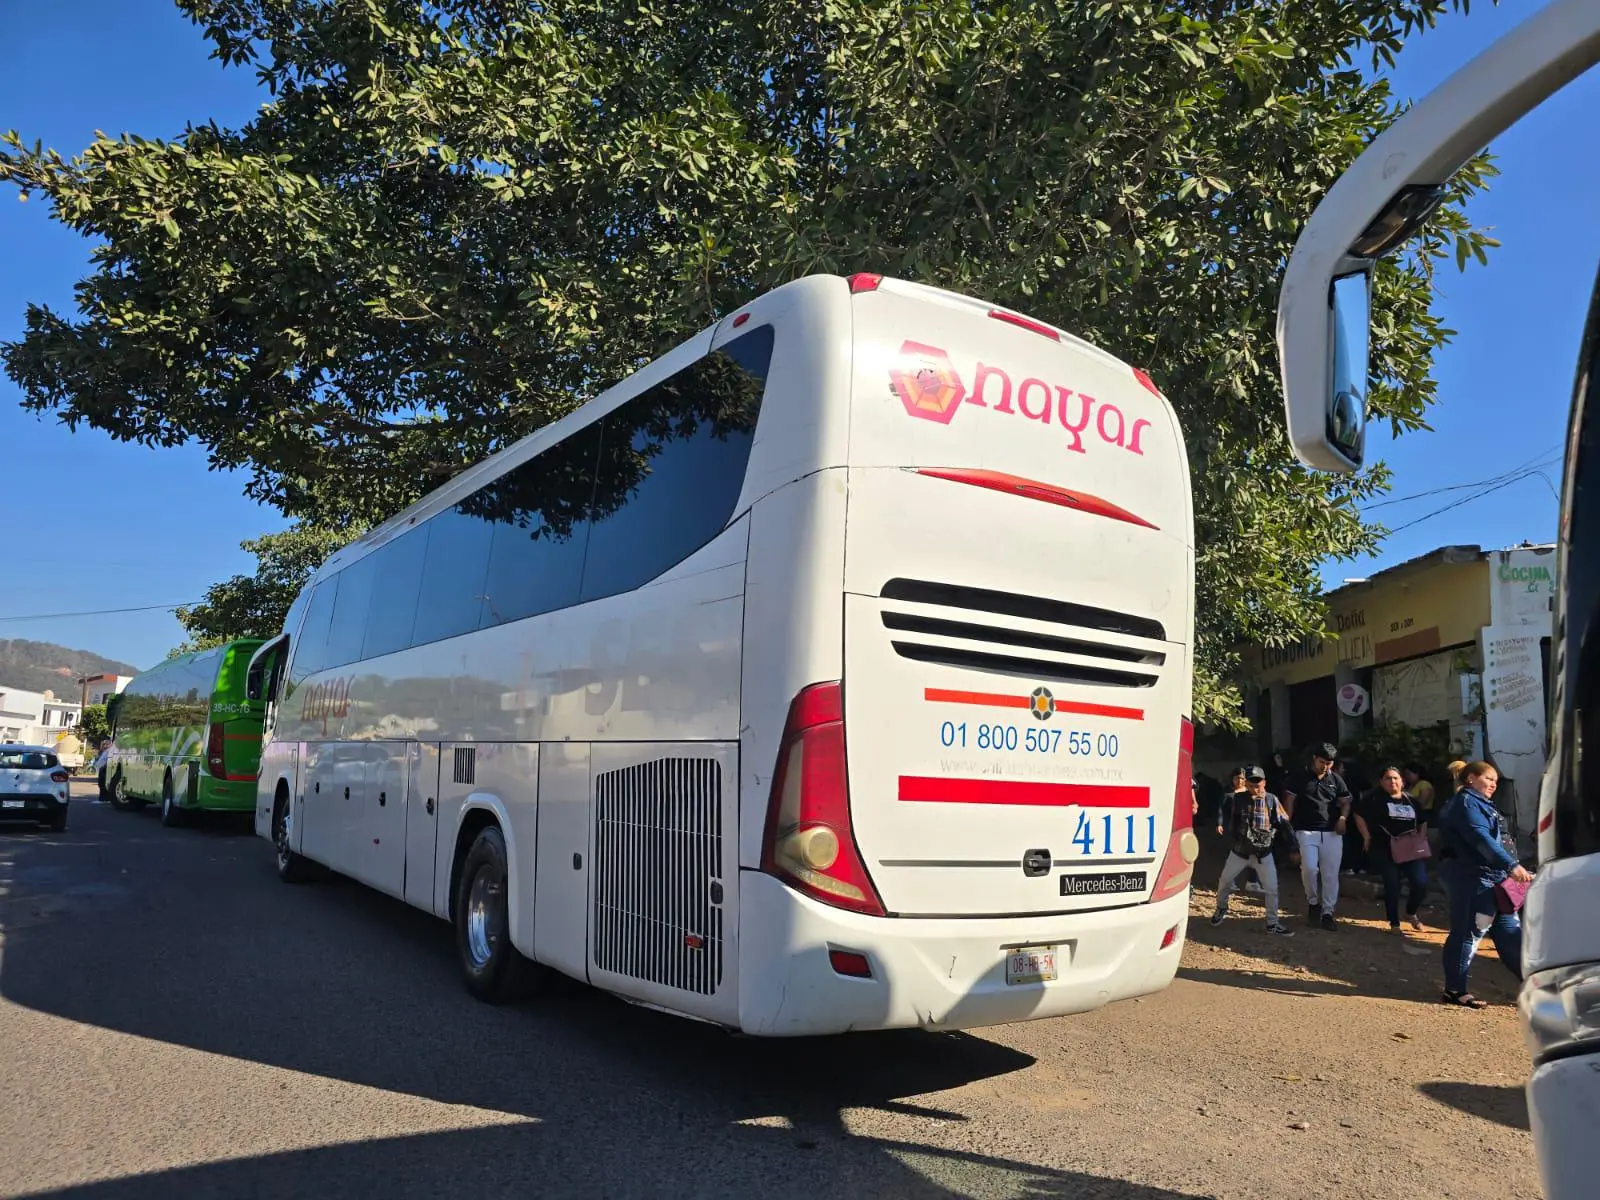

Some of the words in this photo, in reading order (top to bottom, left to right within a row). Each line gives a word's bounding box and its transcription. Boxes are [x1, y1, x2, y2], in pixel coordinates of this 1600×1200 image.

[940, 721, 968, 747] 01
[977, 724, 1018, 751] 800
[1025, 728, 1062, 753] 507
[1069, 731, 1092, 756] 55
[1097, 734, 1119, 758] 00
[1071, 810, 1157, 855] 4111
[1064, 874, 1144, 895] Mercedes-Benz
